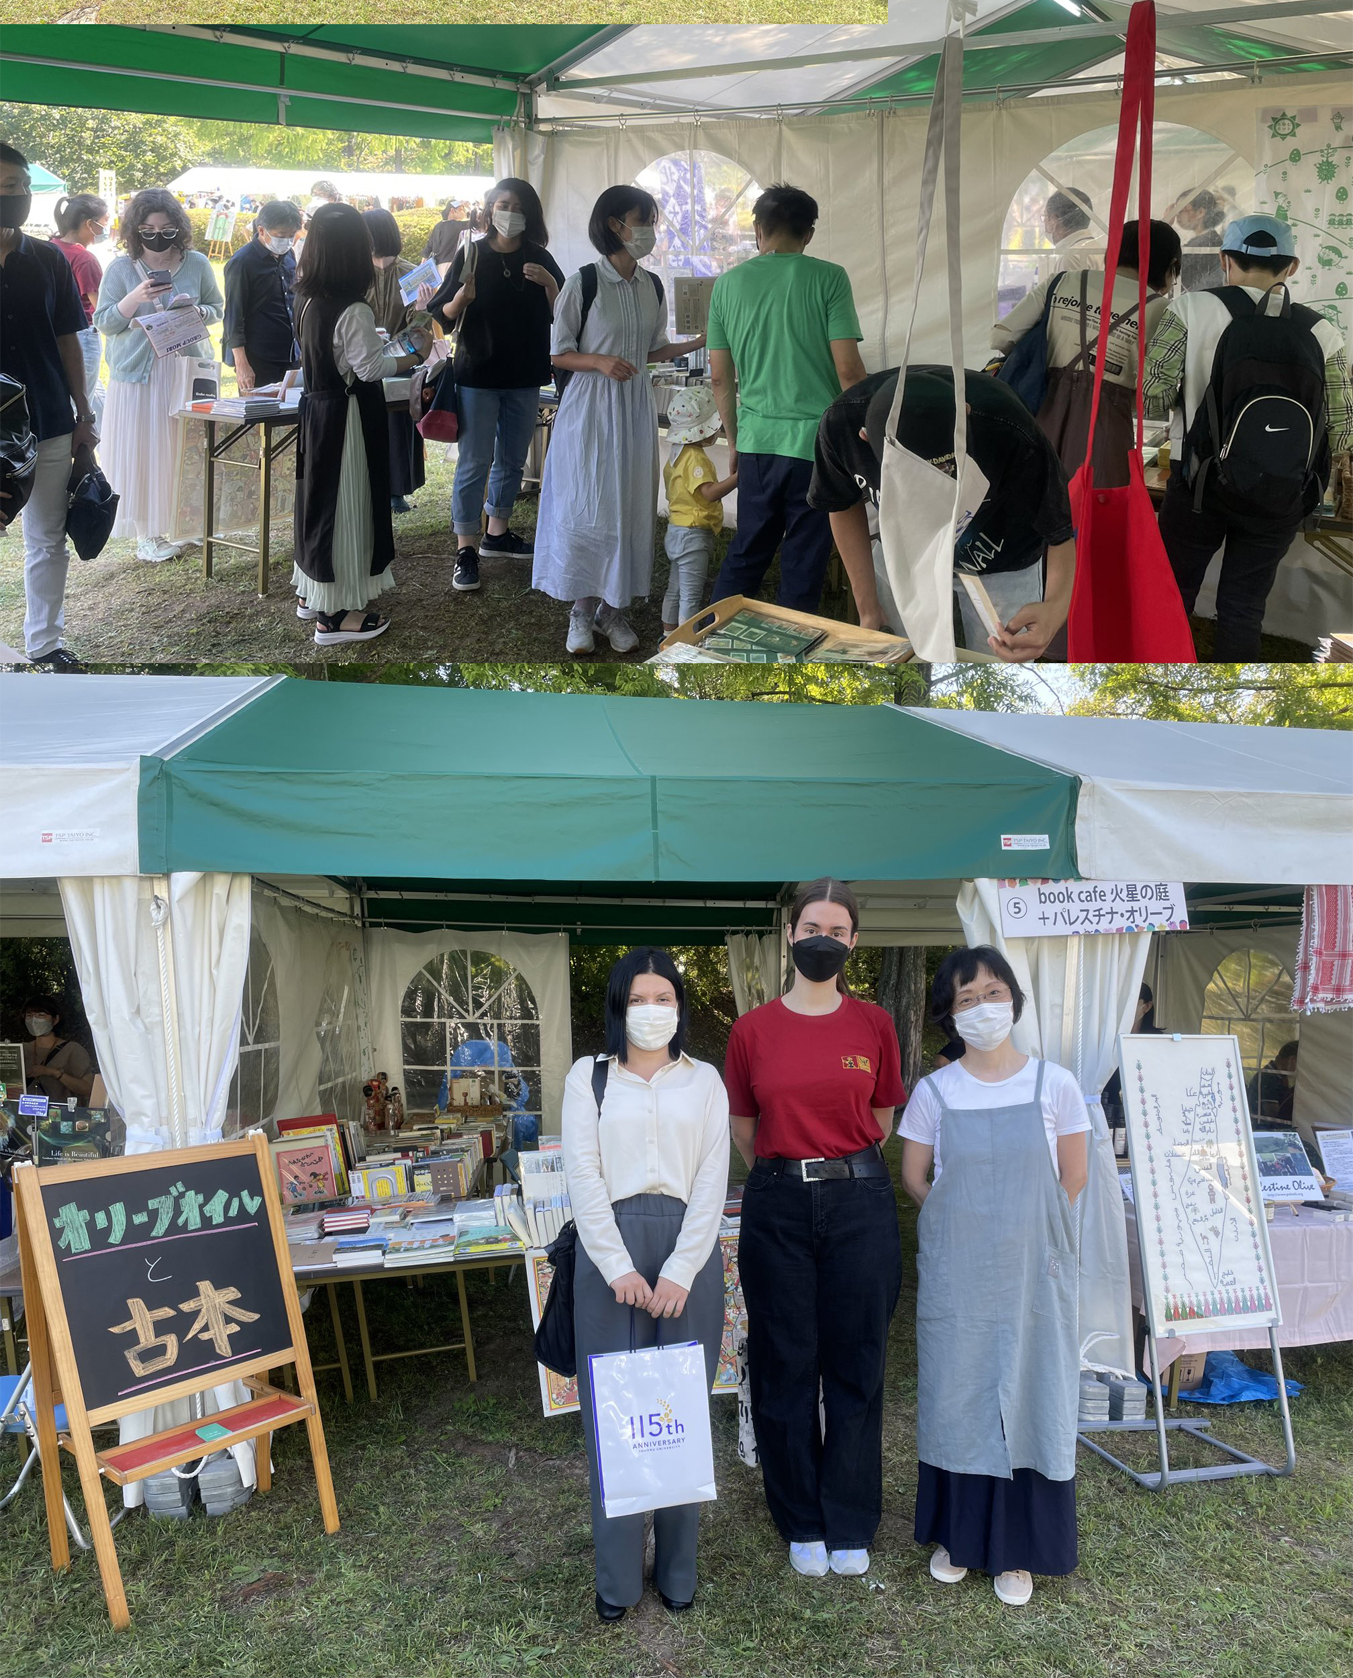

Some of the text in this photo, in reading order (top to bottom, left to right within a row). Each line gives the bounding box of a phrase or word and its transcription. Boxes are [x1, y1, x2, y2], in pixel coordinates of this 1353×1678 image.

[1037, 887, 1075, 904] book
[1077, 885, 1107, 903] cafe
[1110, 882, 1170, 903] 火星の庭
[71, 1150, 99, 1158] Beautiful
[1260, 1180, 1315, 1192] estine Olive
[52, 1181, 263, 1254] オリーブオイル
[144, 1256, 173, 1282] と
[107, 1280, 262, 1378] 古本
[630, 1413, 685, 1440] 115th
[632, 1437, 687, 1450] ANNIVERSARY
